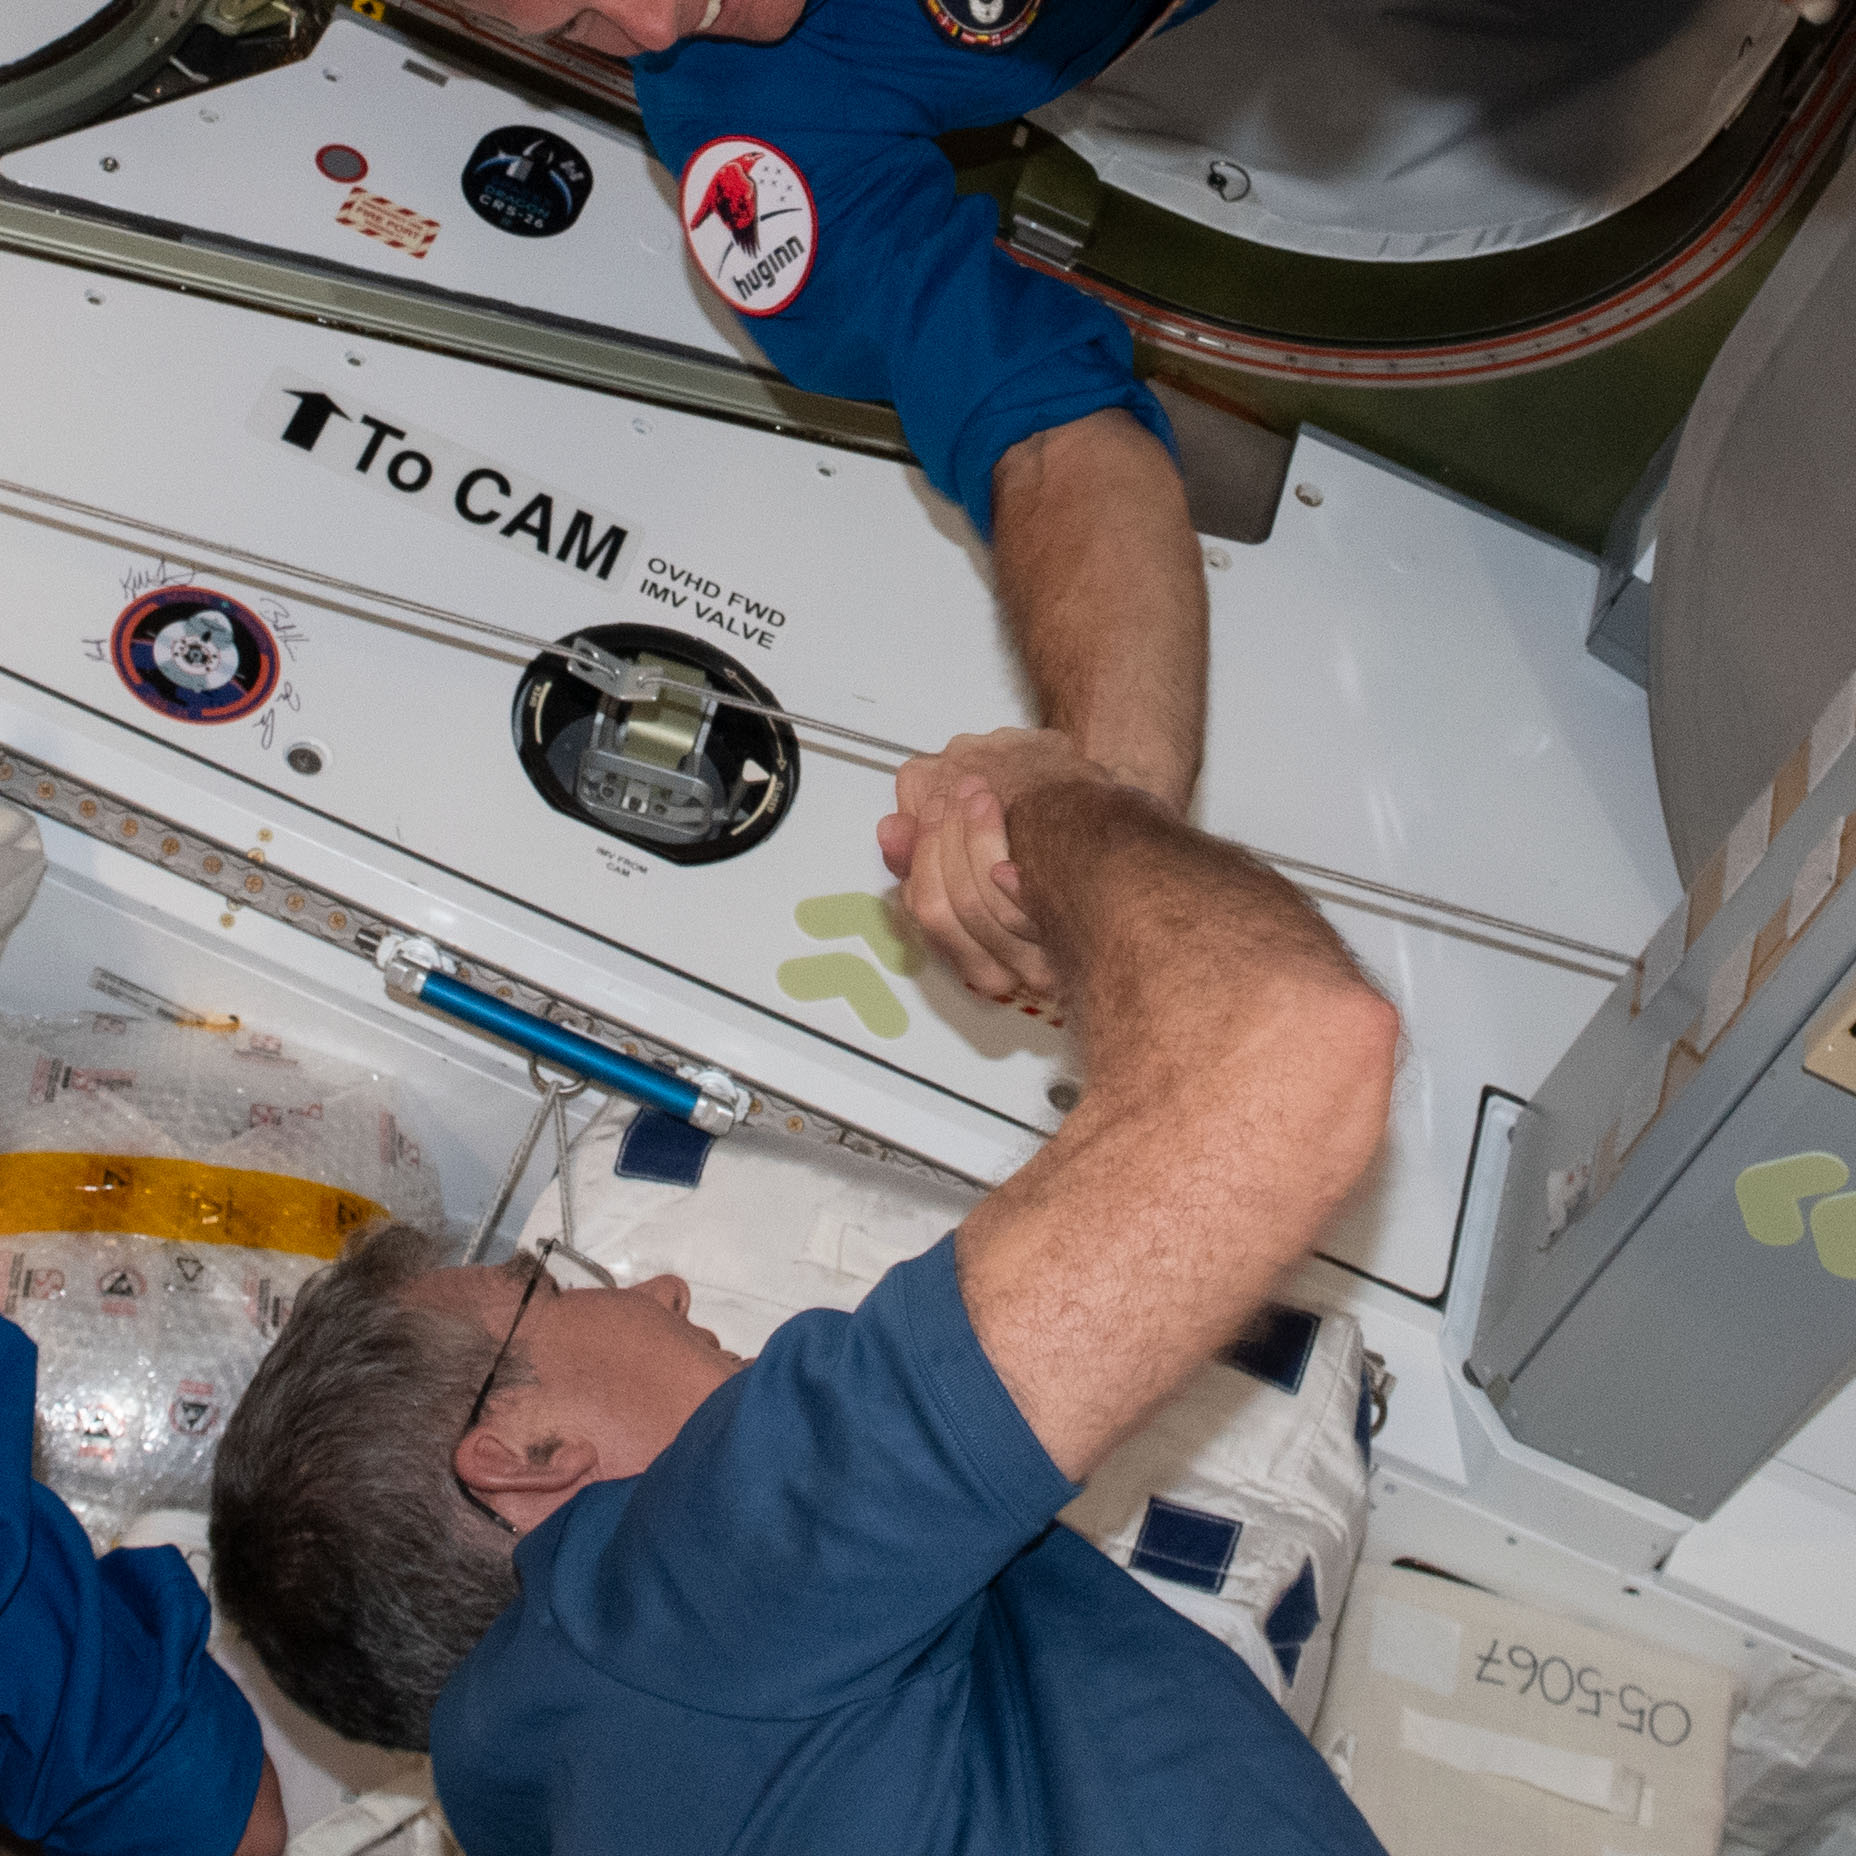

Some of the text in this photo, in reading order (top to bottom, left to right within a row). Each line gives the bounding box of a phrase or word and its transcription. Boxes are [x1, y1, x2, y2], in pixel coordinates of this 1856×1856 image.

[355, 206, 382, 222] FIRE
[386, 220, 418, 239] PORT
[478, 193, 544, 228] CRS-26
[732, 234, 806, 300] huginn
[355, 414, 629, 581] To CAM
[640, 578, 777, 651] IMV VALVE
[647, 556, 787, 629] OVHD FWD
[605, 861, 630, 878] CAM
[615, 855, 648, 874] FROM
